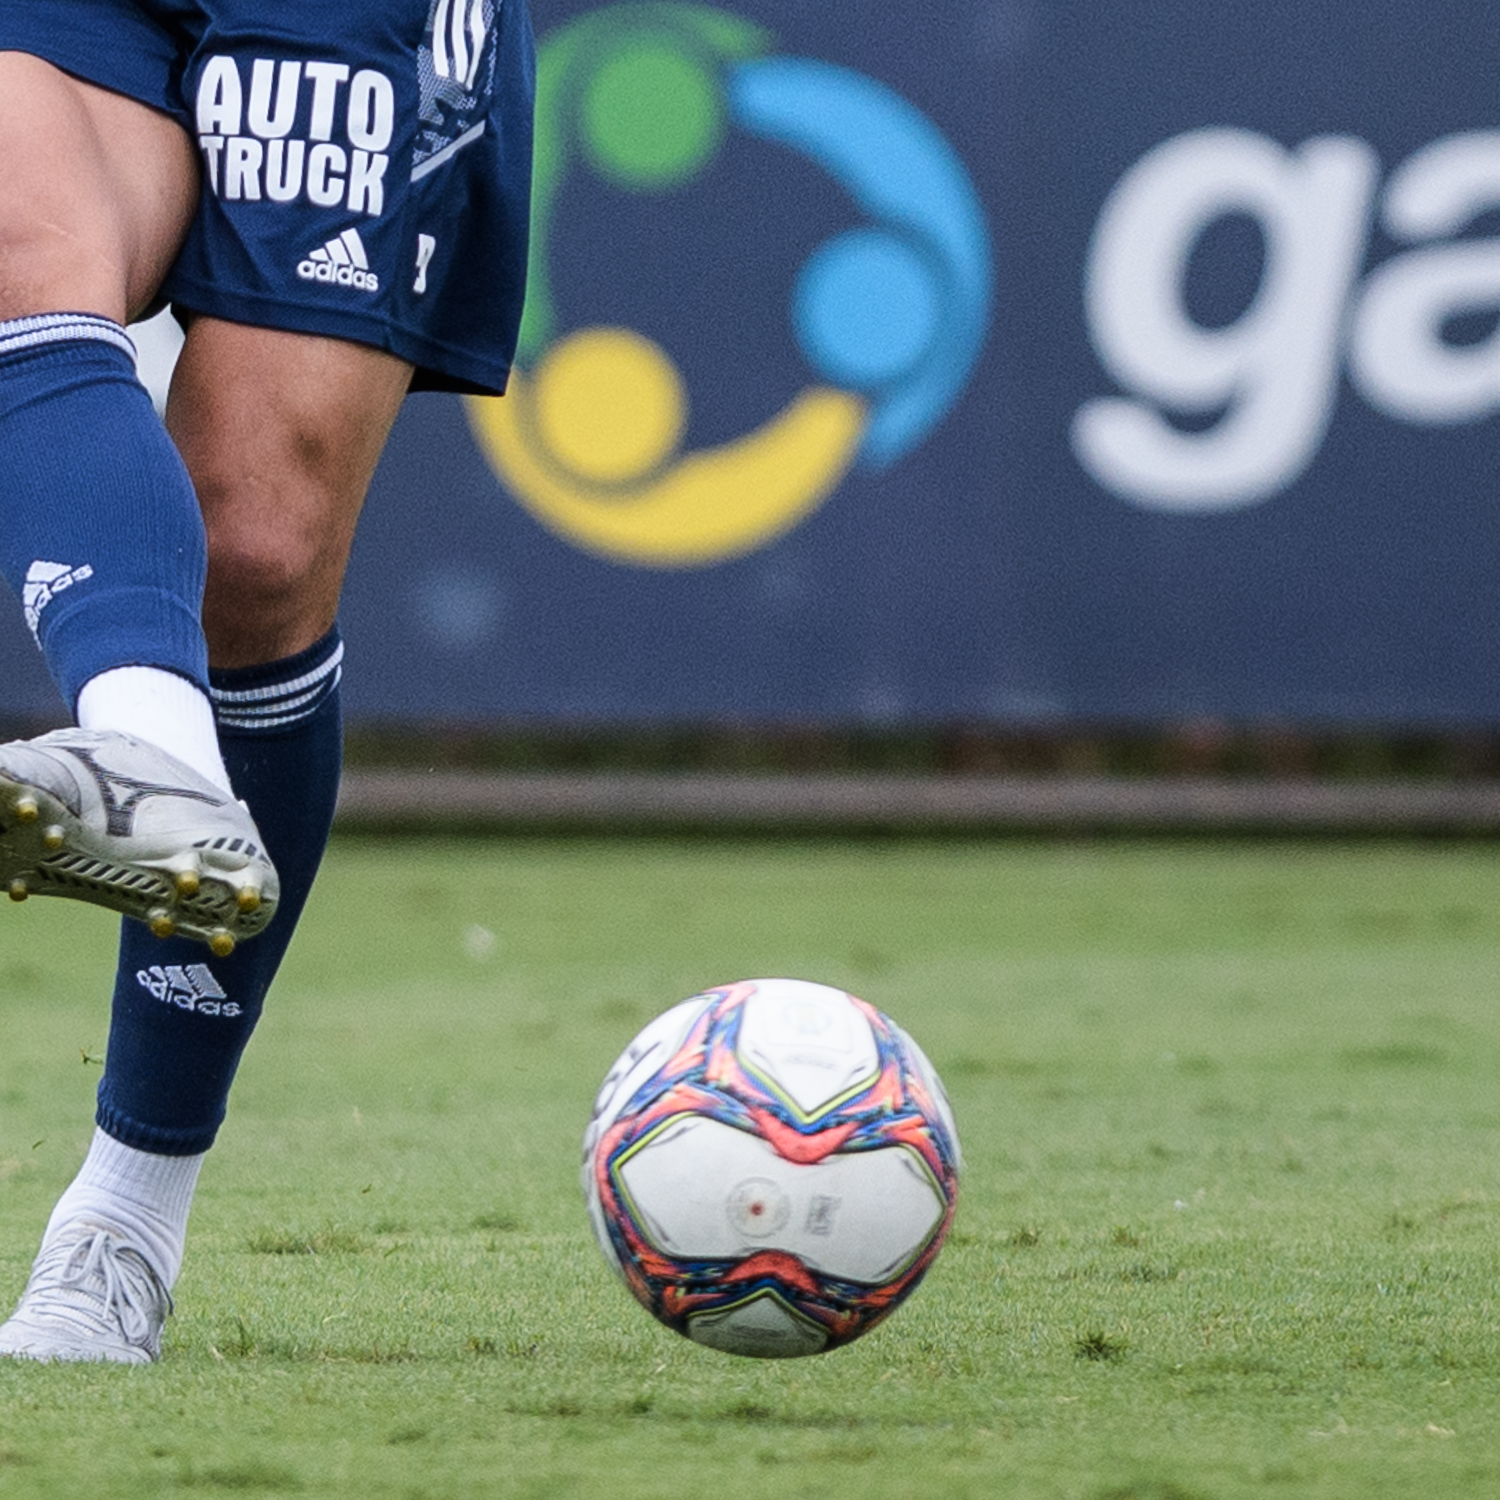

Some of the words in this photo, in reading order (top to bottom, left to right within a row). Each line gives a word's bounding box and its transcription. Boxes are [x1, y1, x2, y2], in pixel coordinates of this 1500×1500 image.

[196, 55, 395, 151] AUTO
[199, 135, 389, 217] TRUCK
[297, 260, 379, 292] adidas
[136, 969, 243, 1017] adidas
